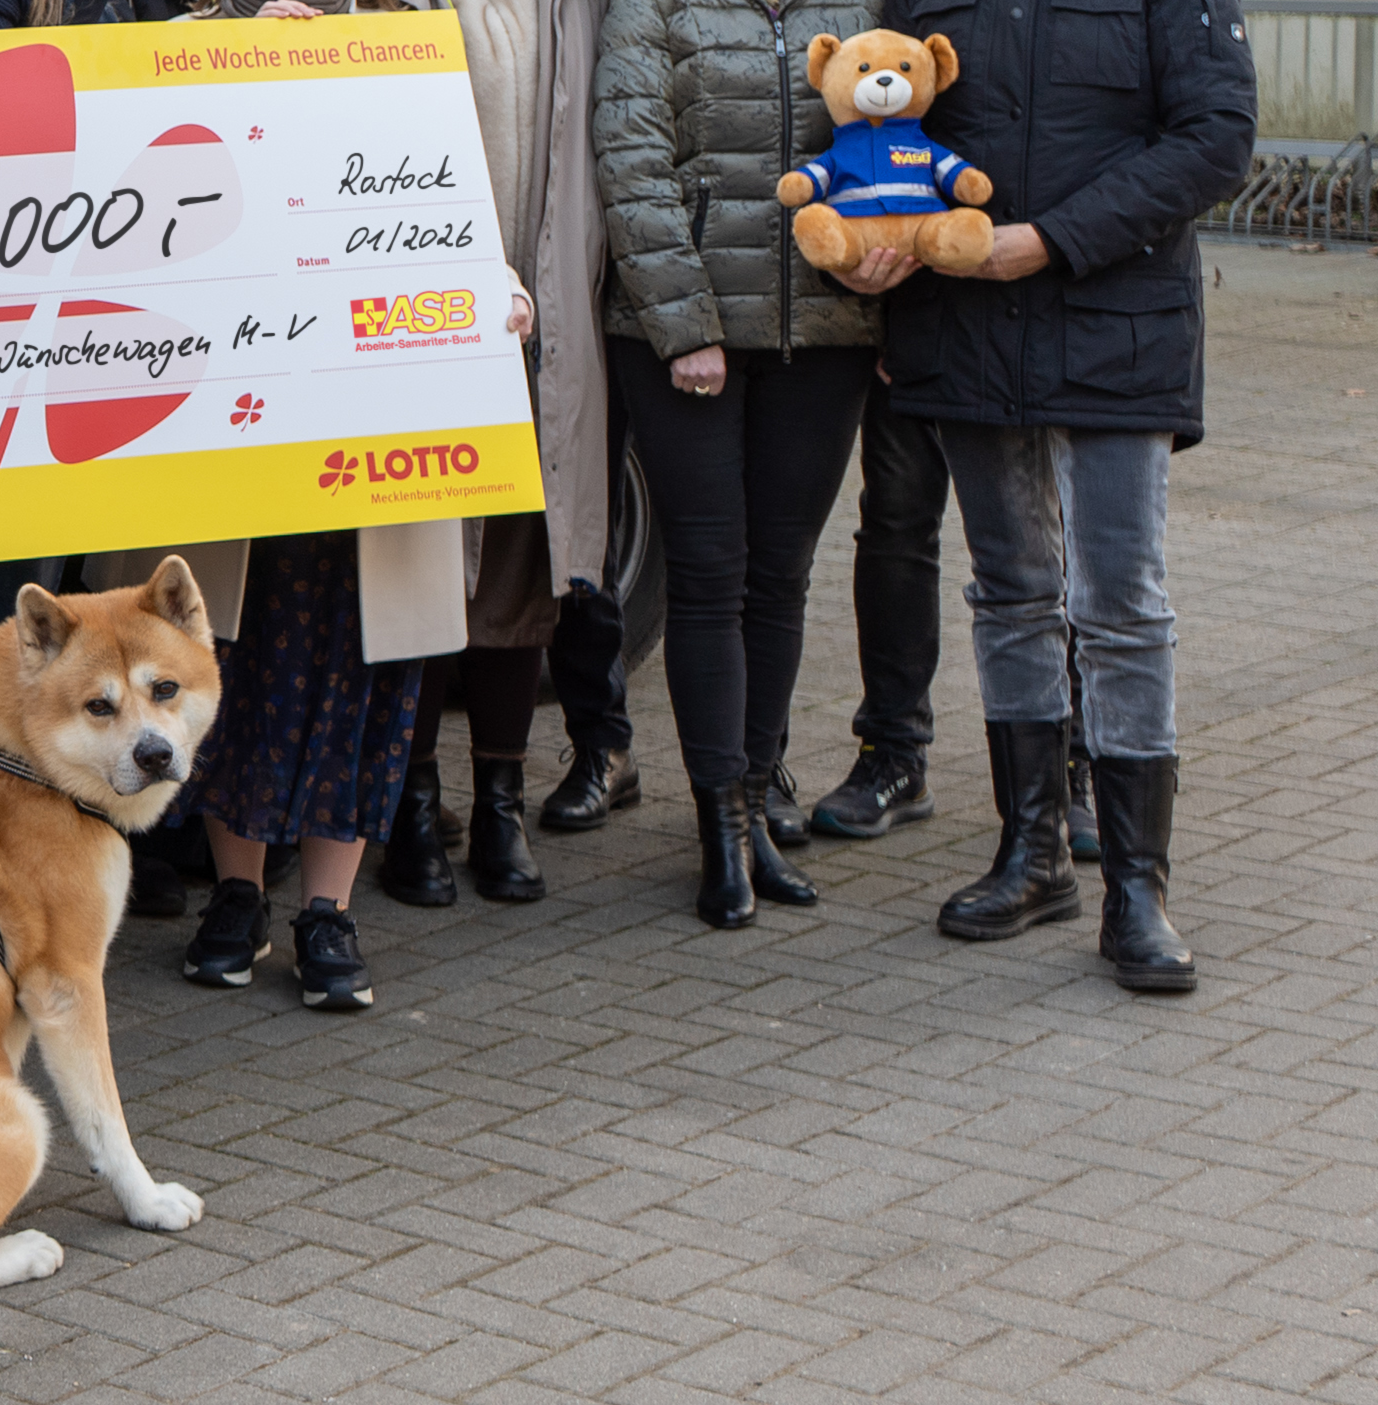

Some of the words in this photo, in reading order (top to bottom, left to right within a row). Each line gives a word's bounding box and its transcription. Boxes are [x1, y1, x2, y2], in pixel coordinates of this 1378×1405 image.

[154, 48, 202, 76] Jede
[207, 45, 281, 70] Woche
[288, 48, 340, 66] neue
[347, 40, 446, 64] Chancen.
[338, 152, 457, 196] Rostock
[287, 197, 305, 208] Ort
[345, 219, 474, 254] 01/2026
[296, 257, 331, 267] Datum
[381, 289, 476, 336] ASB
[355, 333, 482, 353] Arbeiter-Samariter-Bund
[366, 443, 480, 483] LOTTO
[371, 482, 516, 505] Mecklenburg-Vorpommern
